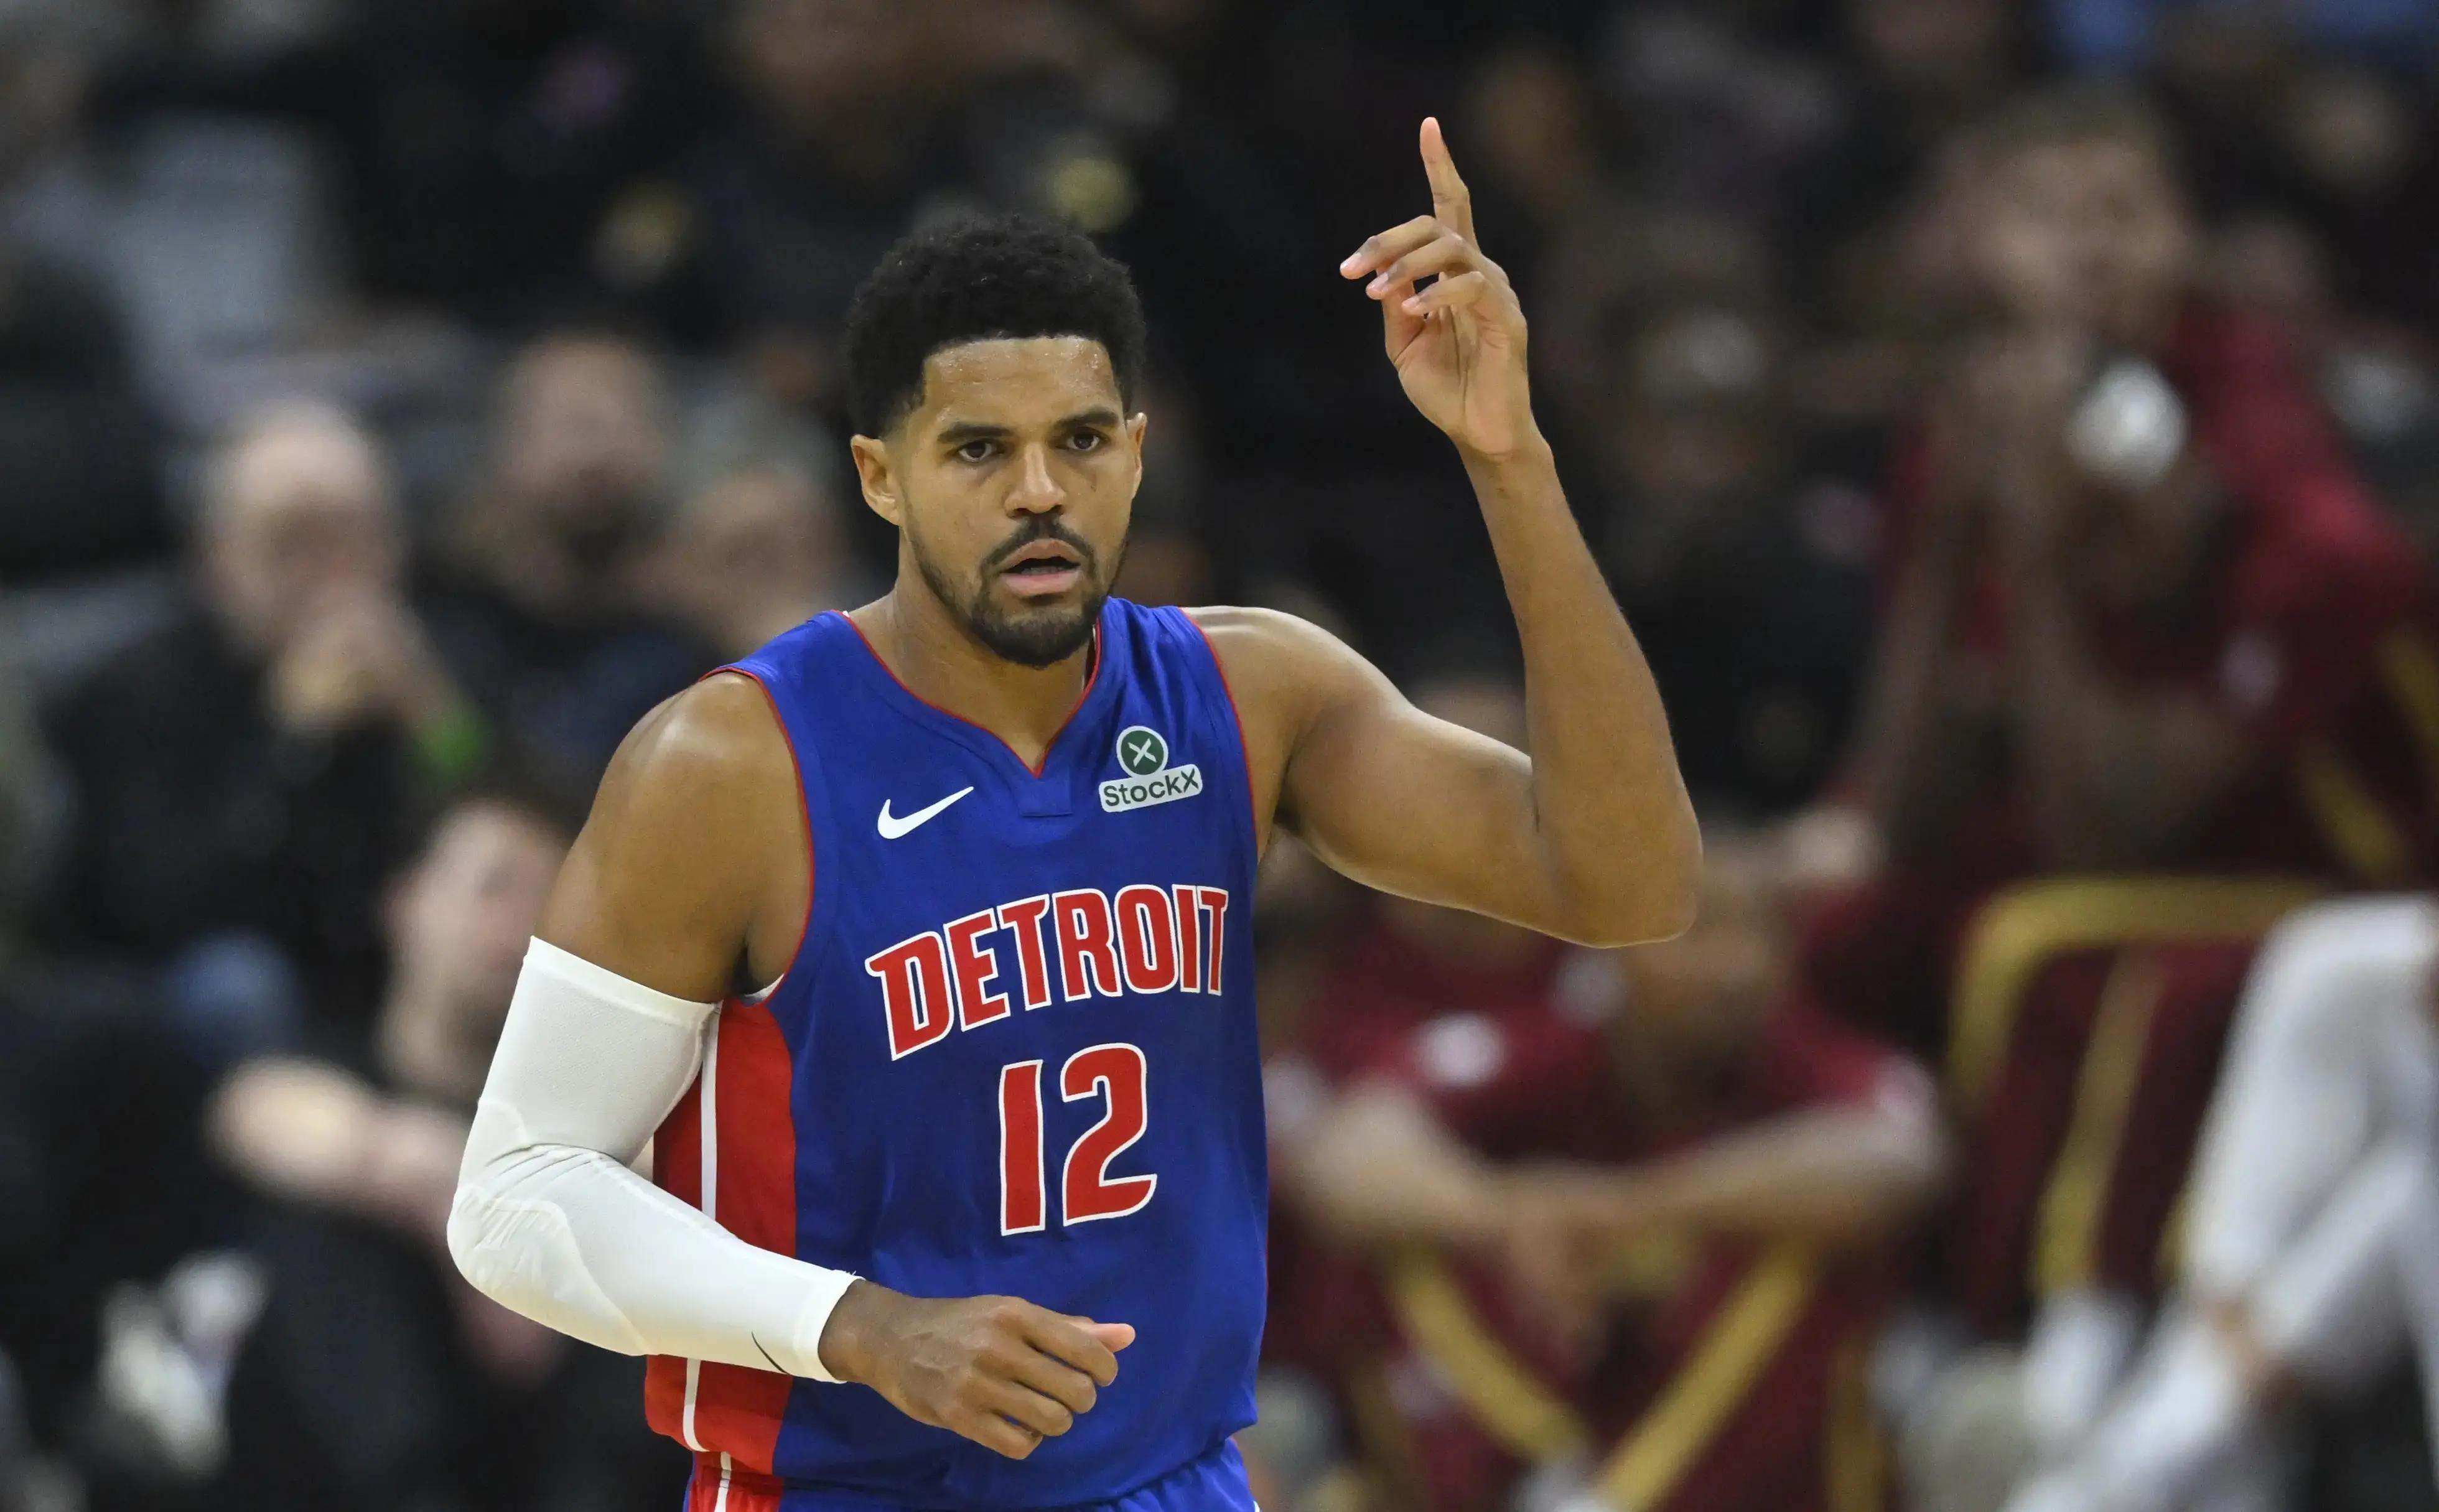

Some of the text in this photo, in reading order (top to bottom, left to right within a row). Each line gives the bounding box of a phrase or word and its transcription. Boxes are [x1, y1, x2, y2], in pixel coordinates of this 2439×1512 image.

[1103, 768, 1200, 806] StockX
[865, 884, 1229, 1061] DETROIT
[999, 1042, 1157, 1236] 12
